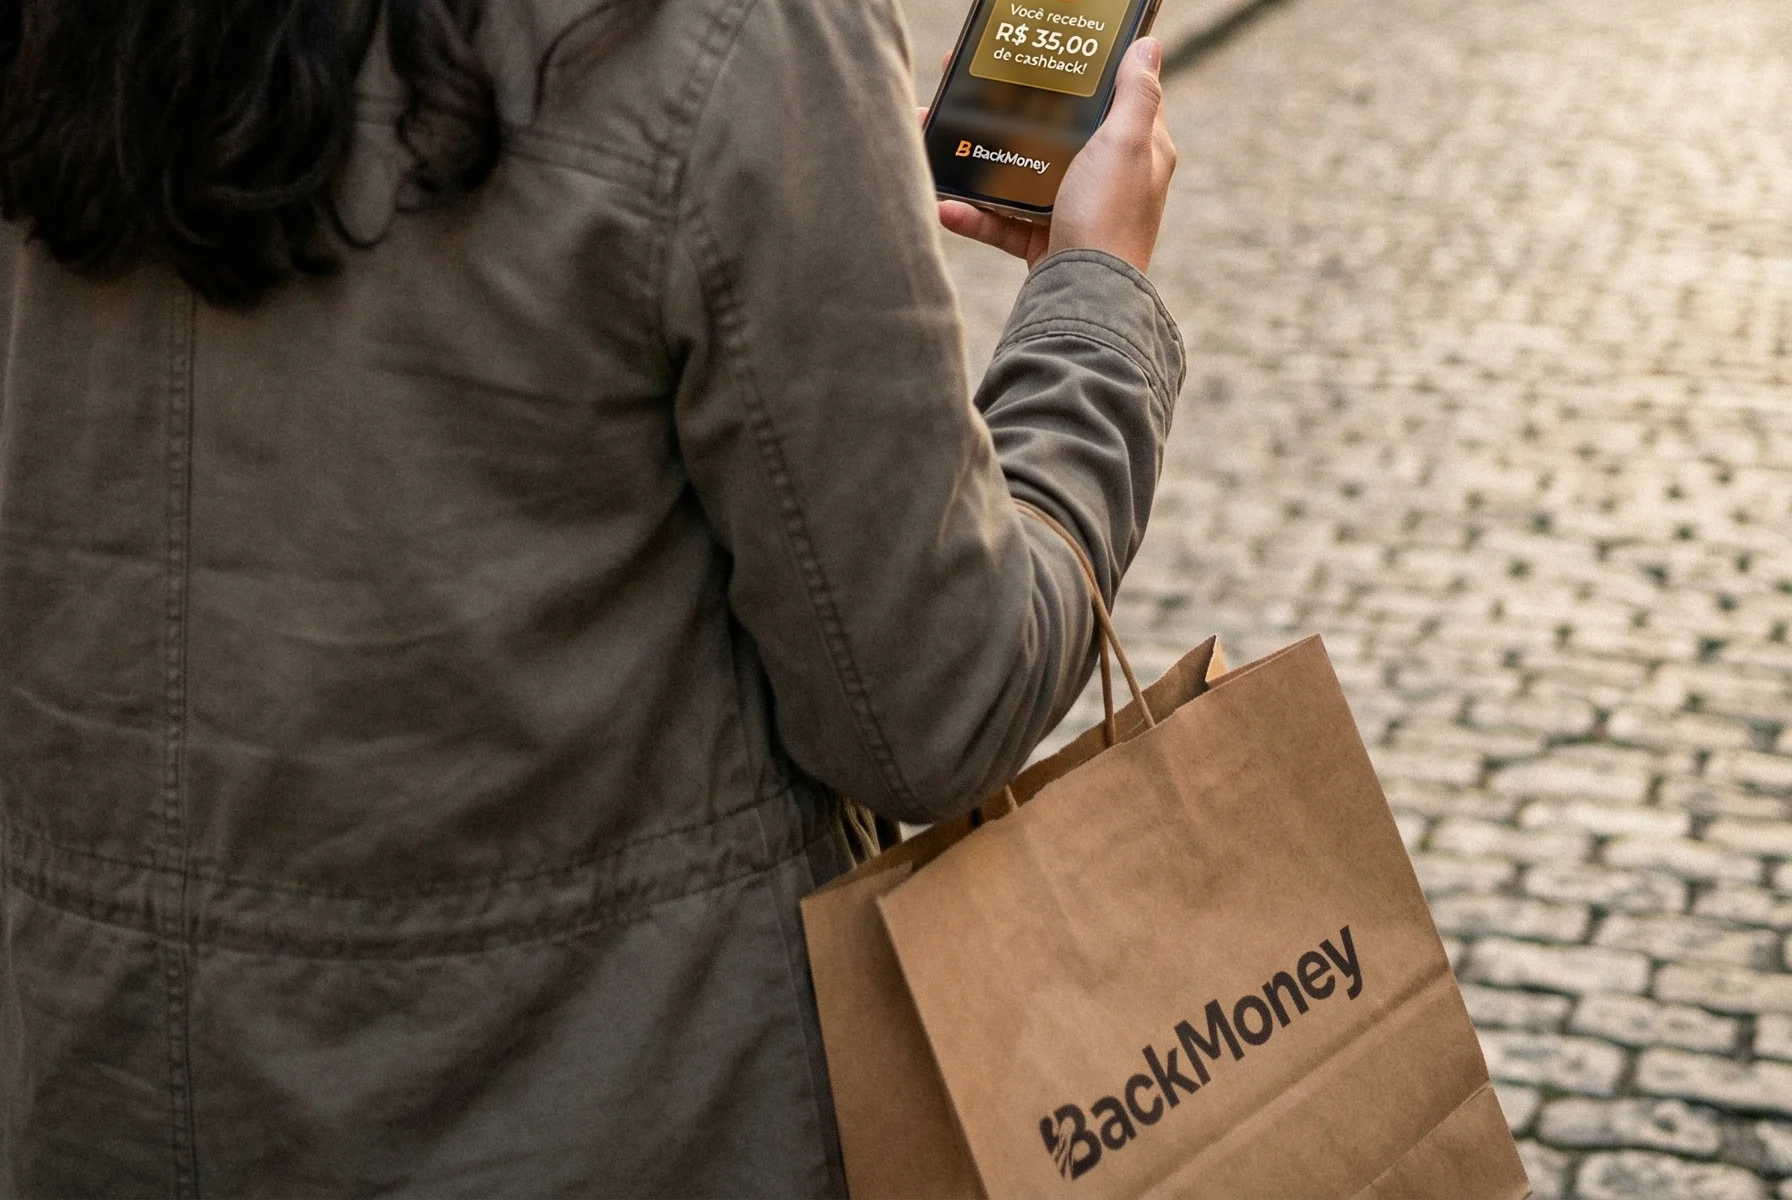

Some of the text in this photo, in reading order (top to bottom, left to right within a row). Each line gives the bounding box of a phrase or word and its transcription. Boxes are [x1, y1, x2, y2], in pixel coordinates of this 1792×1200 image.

[1010, 3, 1105, 31] Você recebeu
[995, 22, 1099, 57] R$ 35,00
[993, 47, 1088, 75] de cashback!
[972, 144, 1051, 175] BackMoney
[1039, 924, 1364, 1182] BackMoney
